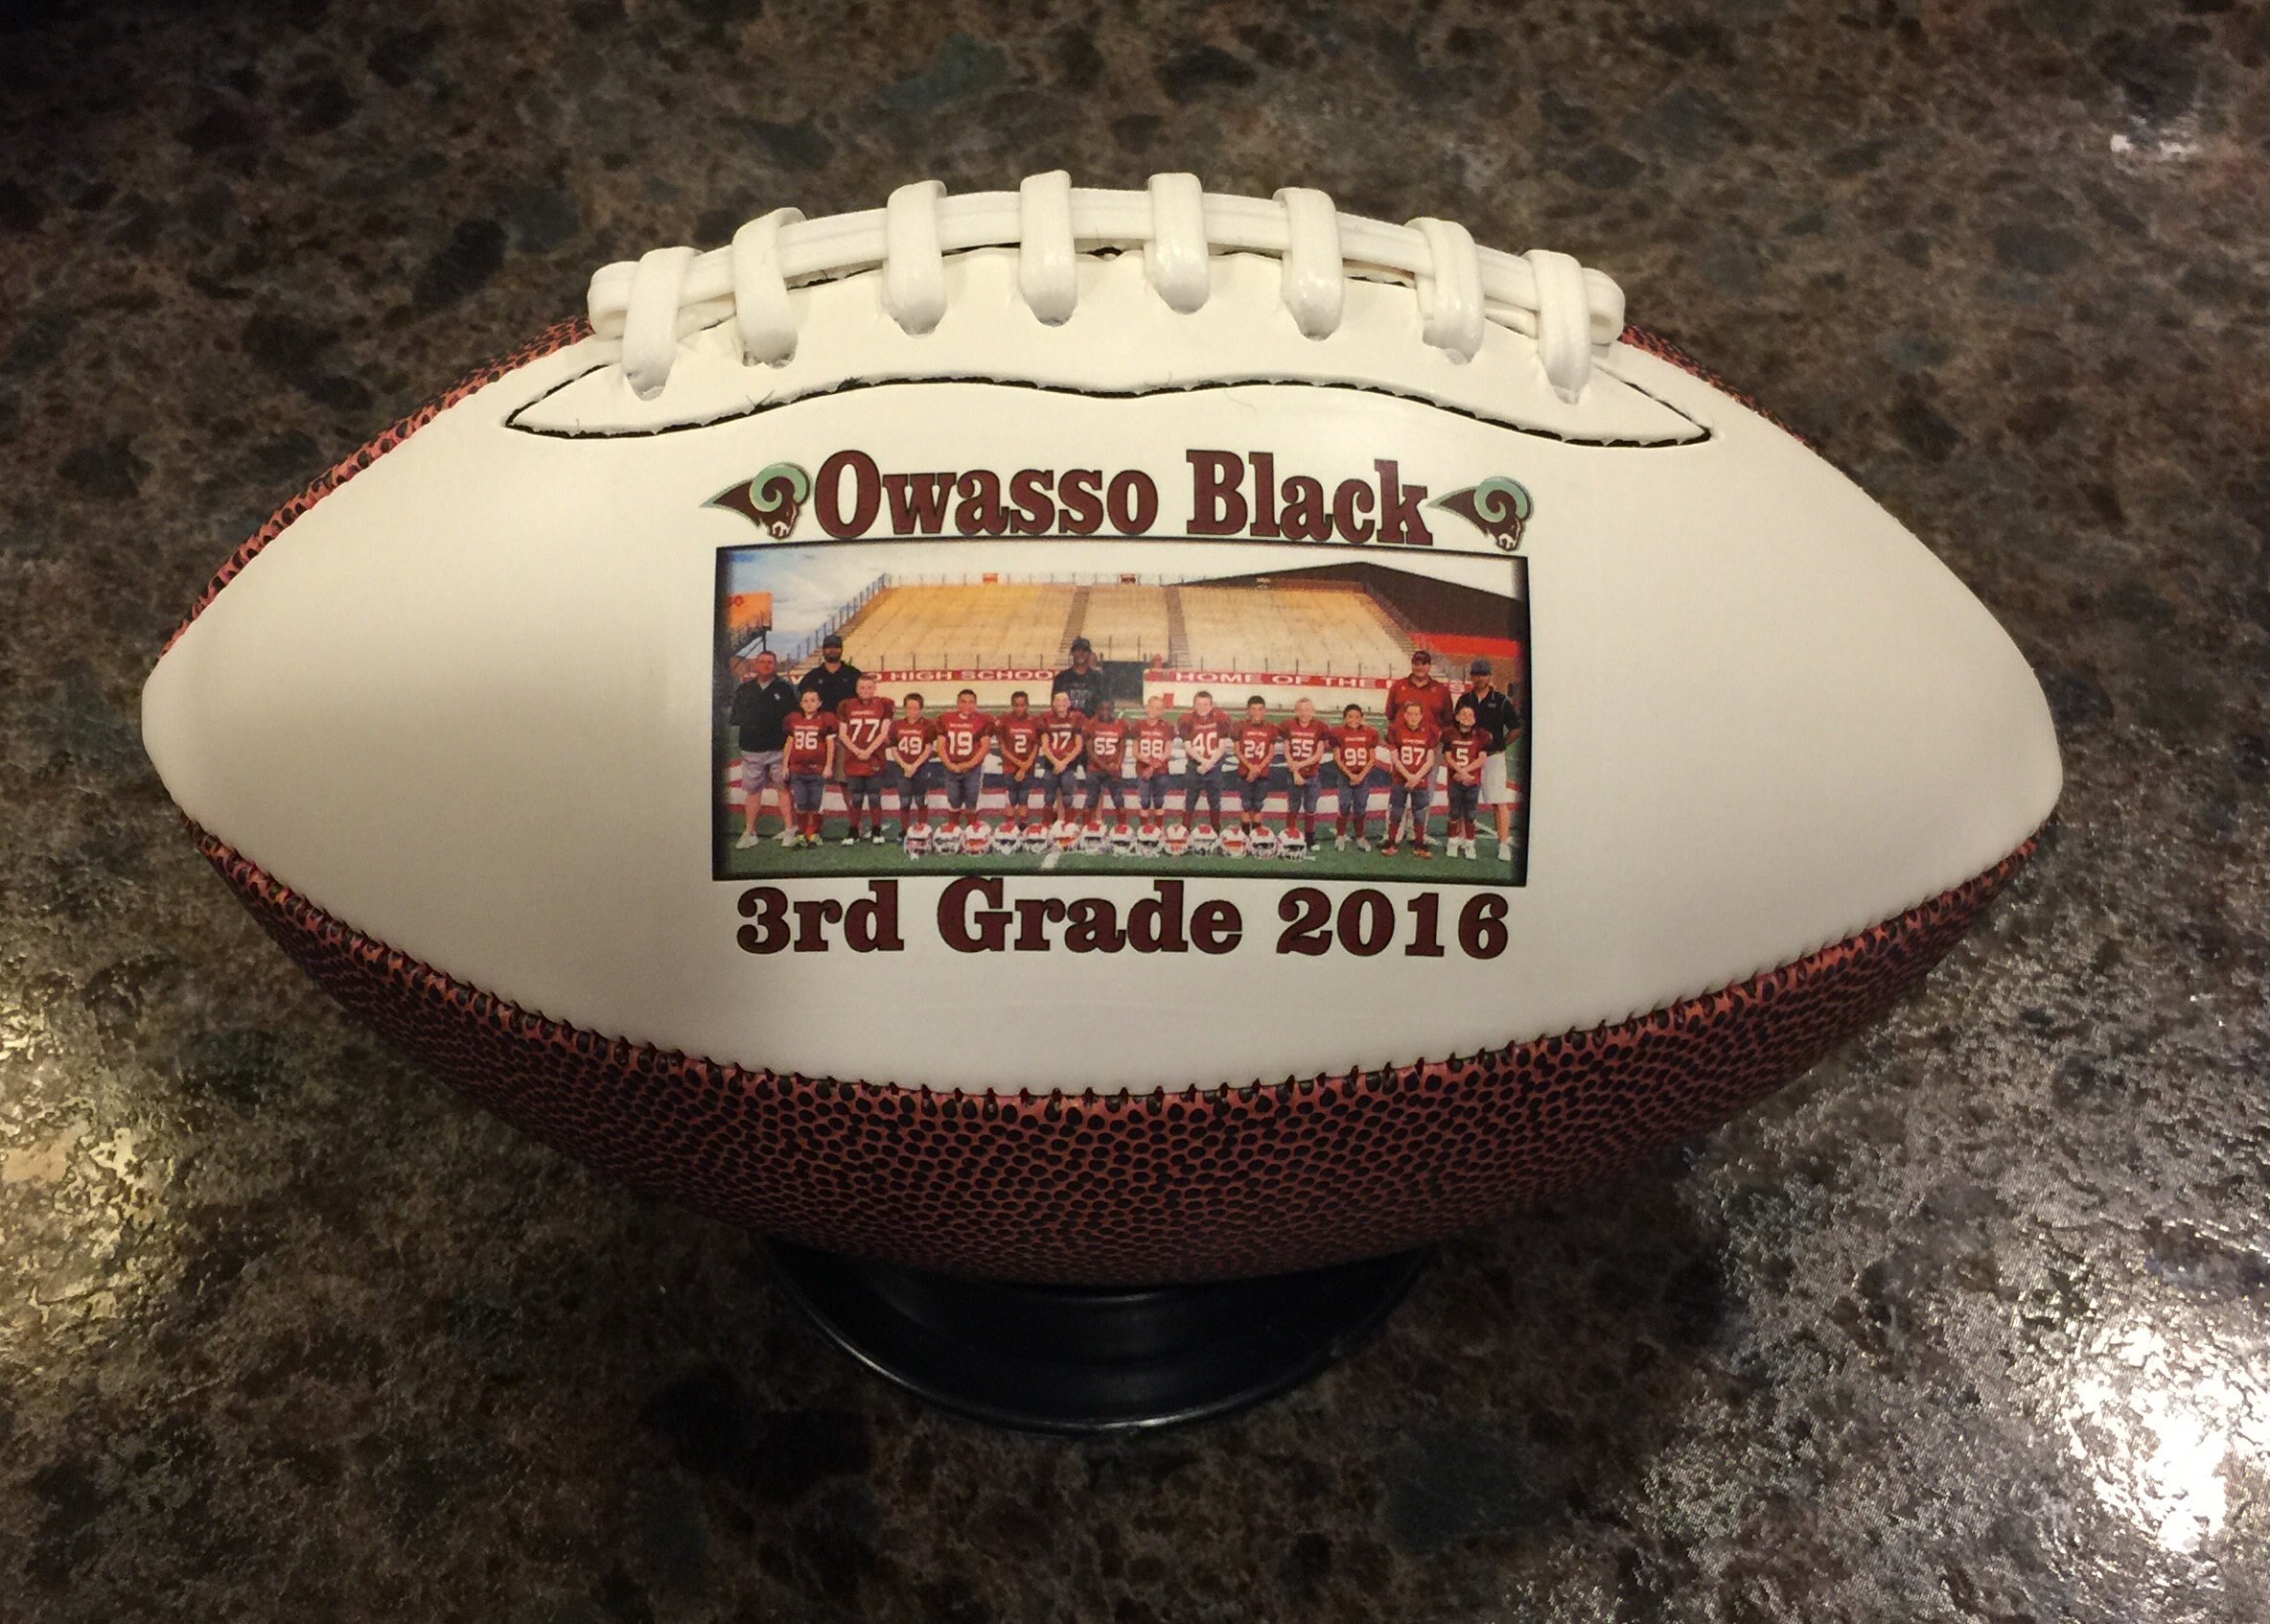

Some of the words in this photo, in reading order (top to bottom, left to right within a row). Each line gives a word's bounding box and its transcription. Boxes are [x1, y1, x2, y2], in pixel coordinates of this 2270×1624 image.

[814, 450, 1159, 540] Owasso
[1186, 449, 1433, 546] Black
[891, 671, 953, 682] HIGH
[960, 670, 1054, 682] SCHOO
[1175, 672, 1262, 684] HOME
[1272, 675, 1311, 685] OF
[1323, 677, 1376, 688] THE
[849, 718, 880, 743] 77
[898, 736, 922, 755] 49
[948, 731, 973, 755] 19
[1014, 734, 1027, 754] 2
[1052, 731, 1072, 750] 17
[1243, 739, 1265, 759] 24
[1401, 747, 1425, 765] 87
[1456, 749, 1470, 766] 5
[736, 881, 904, 955] 3rd
[937, 876, 1243, 956] Grade
[1276, 890, 1509, 960] 2016
